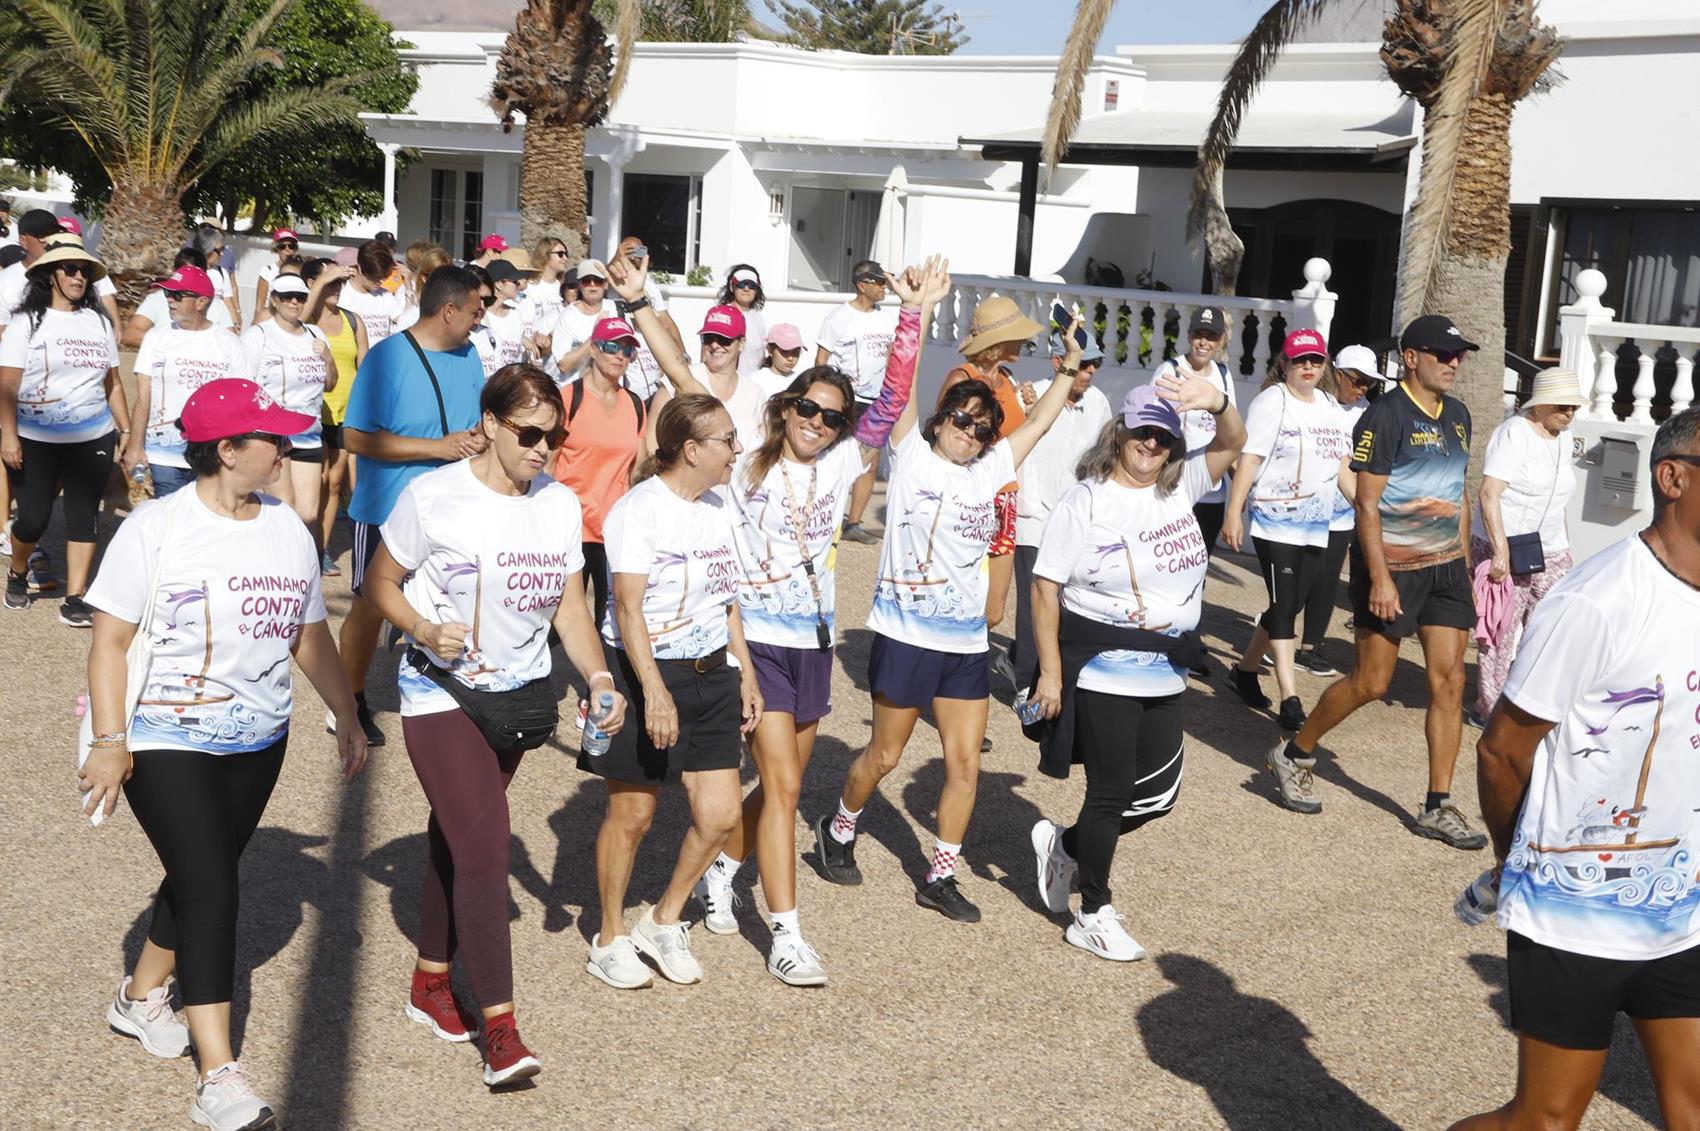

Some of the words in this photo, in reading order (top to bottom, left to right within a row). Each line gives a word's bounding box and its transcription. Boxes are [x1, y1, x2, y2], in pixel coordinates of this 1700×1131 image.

[228, 575, 309, 596] CAMINAMO
[503, 596, 515, 608] EL
[238, 622, 251, 636] EL
